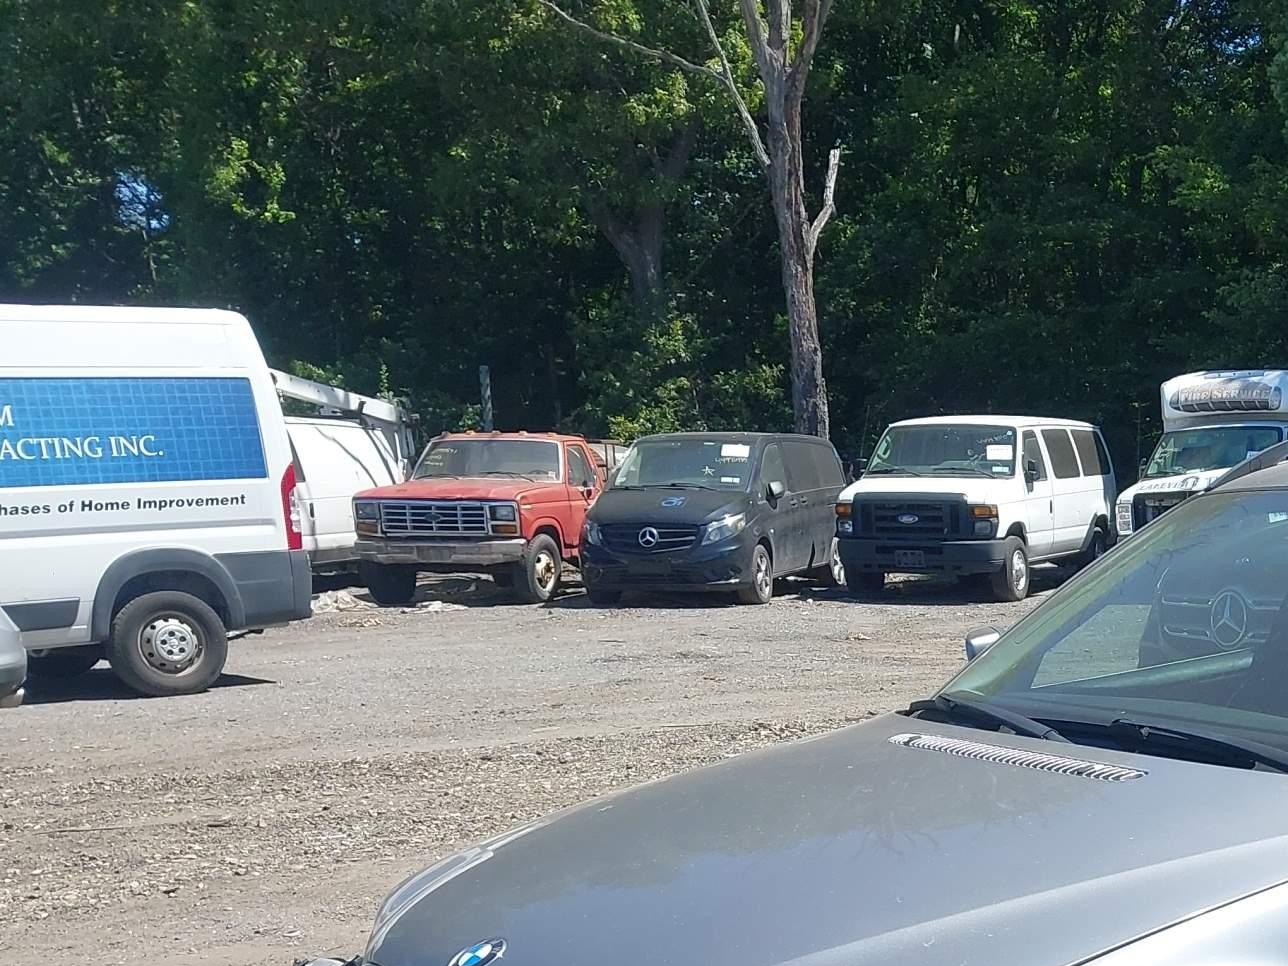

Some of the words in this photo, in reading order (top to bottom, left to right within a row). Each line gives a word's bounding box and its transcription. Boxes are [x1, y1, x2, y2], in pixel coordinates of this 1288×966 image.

[0, 437, 103, 460] ACTING
[109, 435, 164, 457] INC.
[58, 500, 74, 513] of
[81, 498, 131, 512] Home
[137, 493, 247, 512] Improvement
